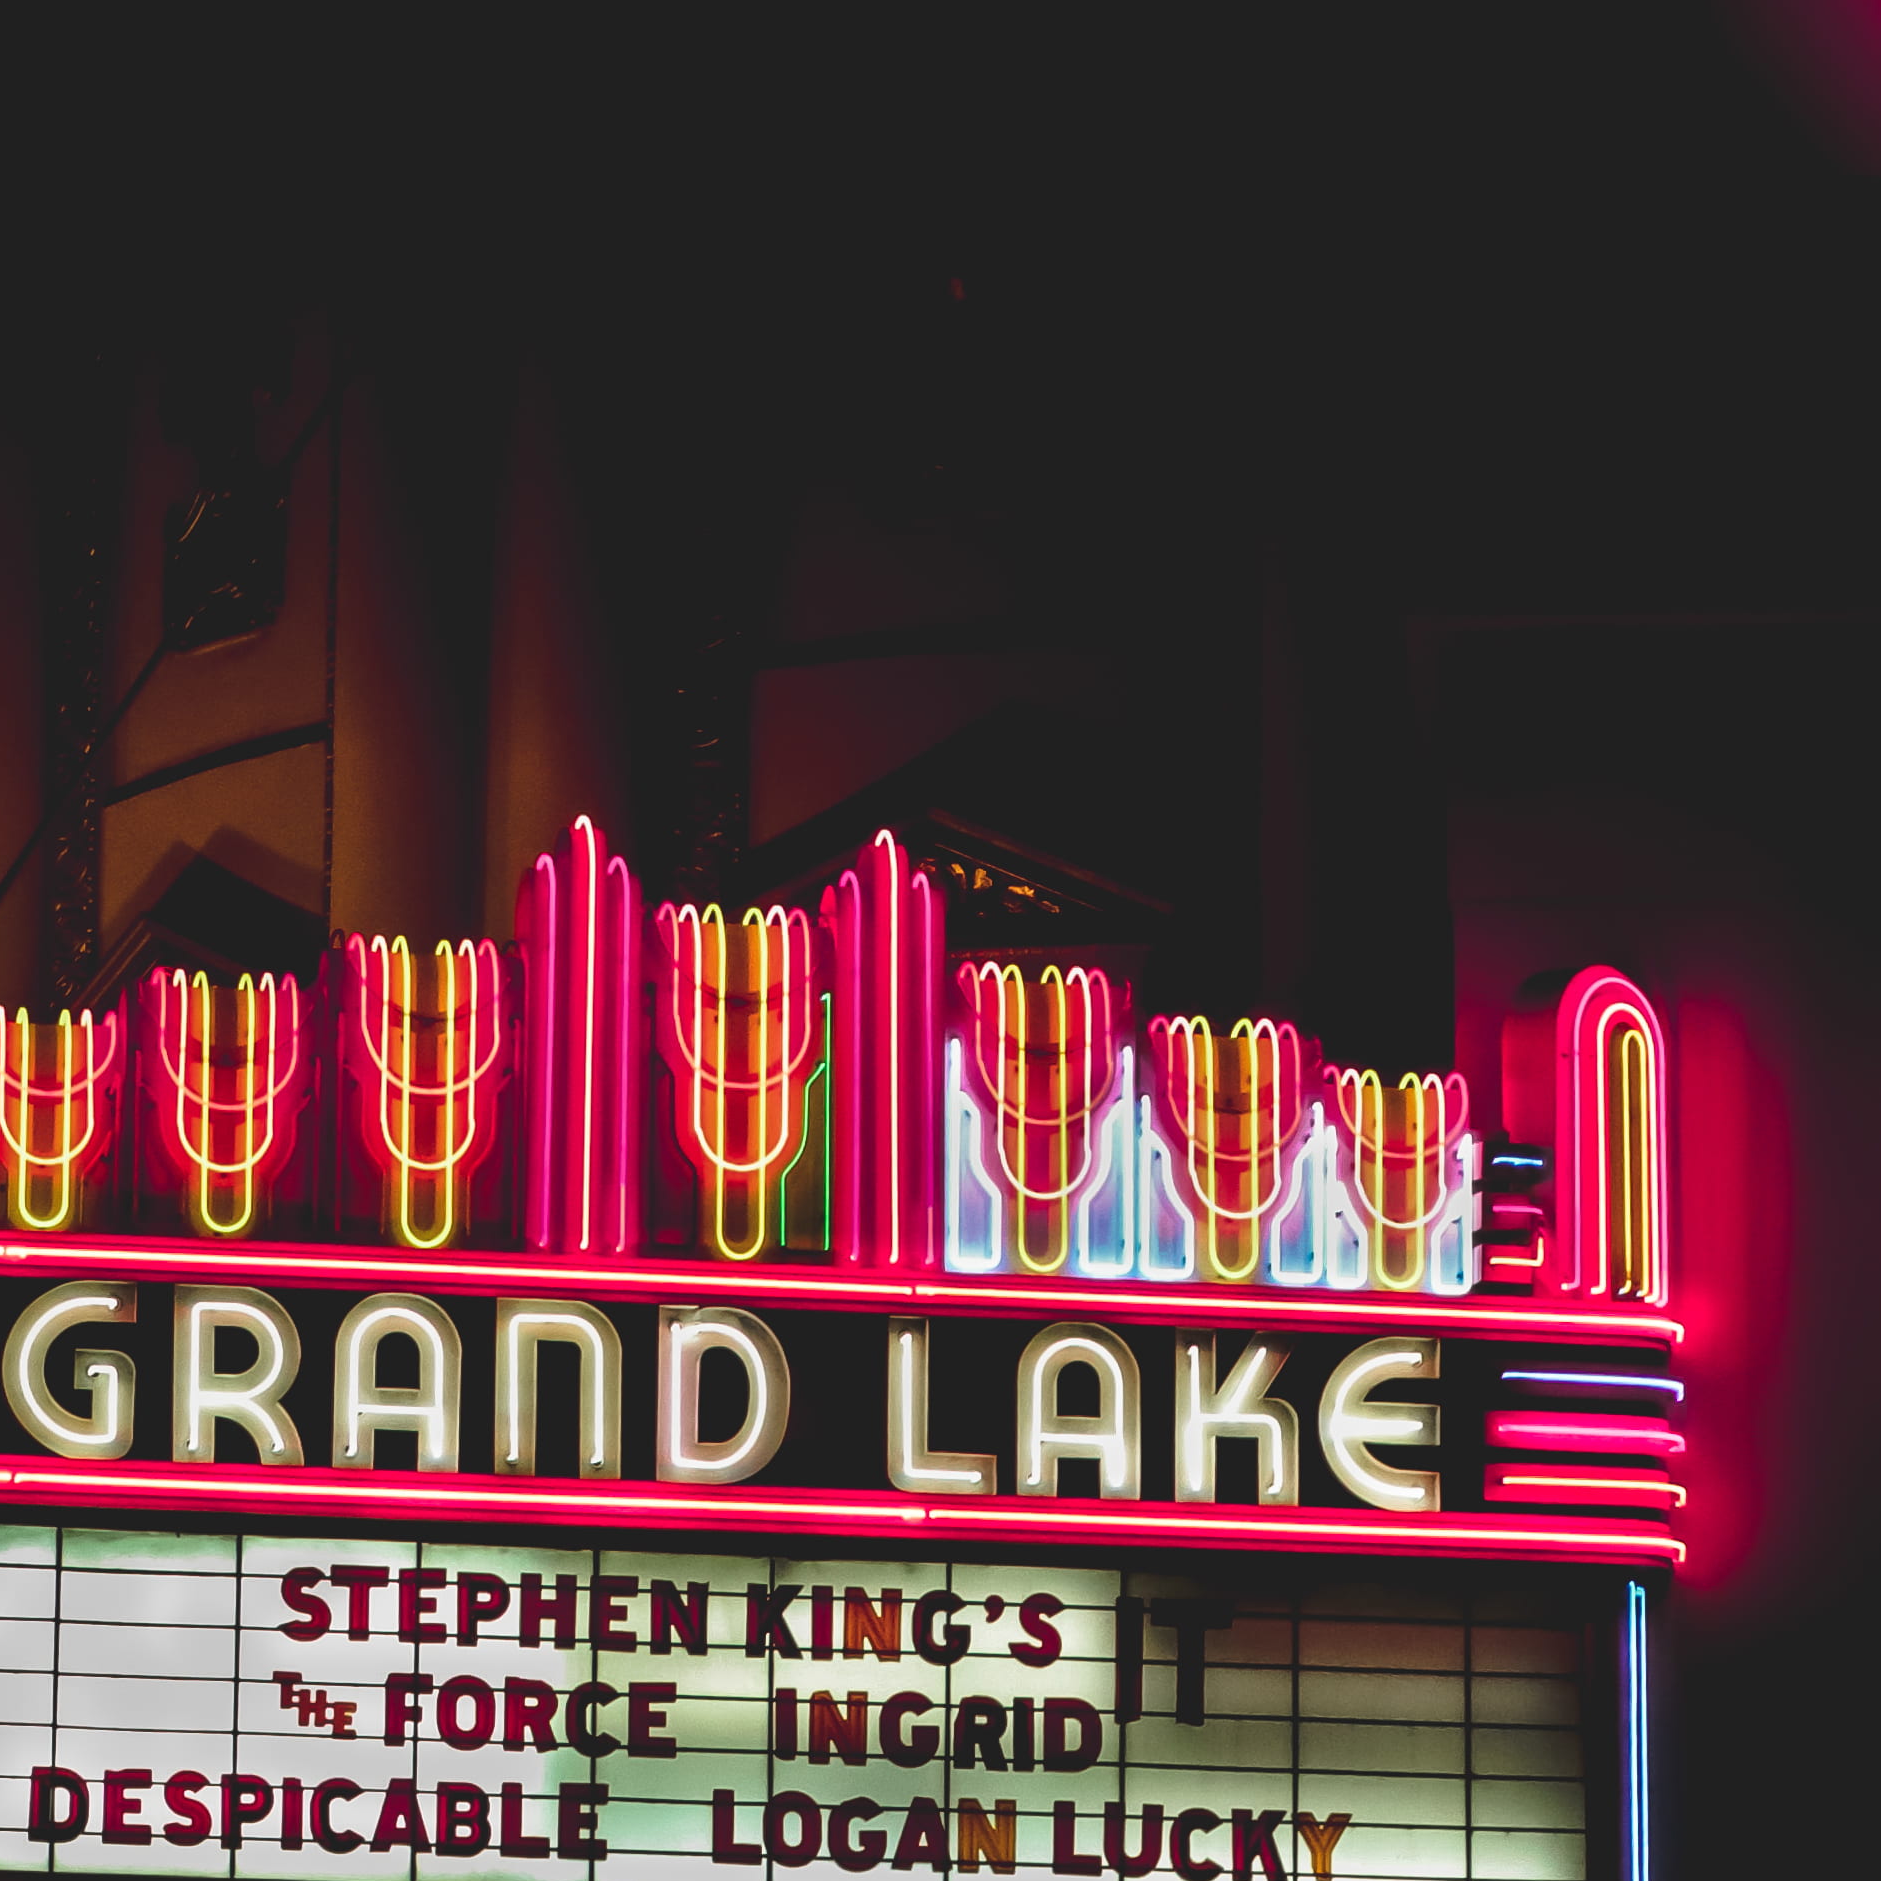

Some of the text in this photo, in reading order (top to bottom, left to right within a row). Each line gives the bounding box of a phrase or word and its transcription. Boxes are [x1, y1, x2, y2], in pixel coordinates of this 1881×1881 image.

[2, 1279, 1441, 1512] GRAND LAKE
[279, 1565, 1234, 1727] STEPHEN KING'S IT
[272, 1670, 1103, 1773] THE FORCE INGRID
[27, 1766, 609, 1862] DESPICABLE
[712, 1789, 1017, 1875] LOGAN
